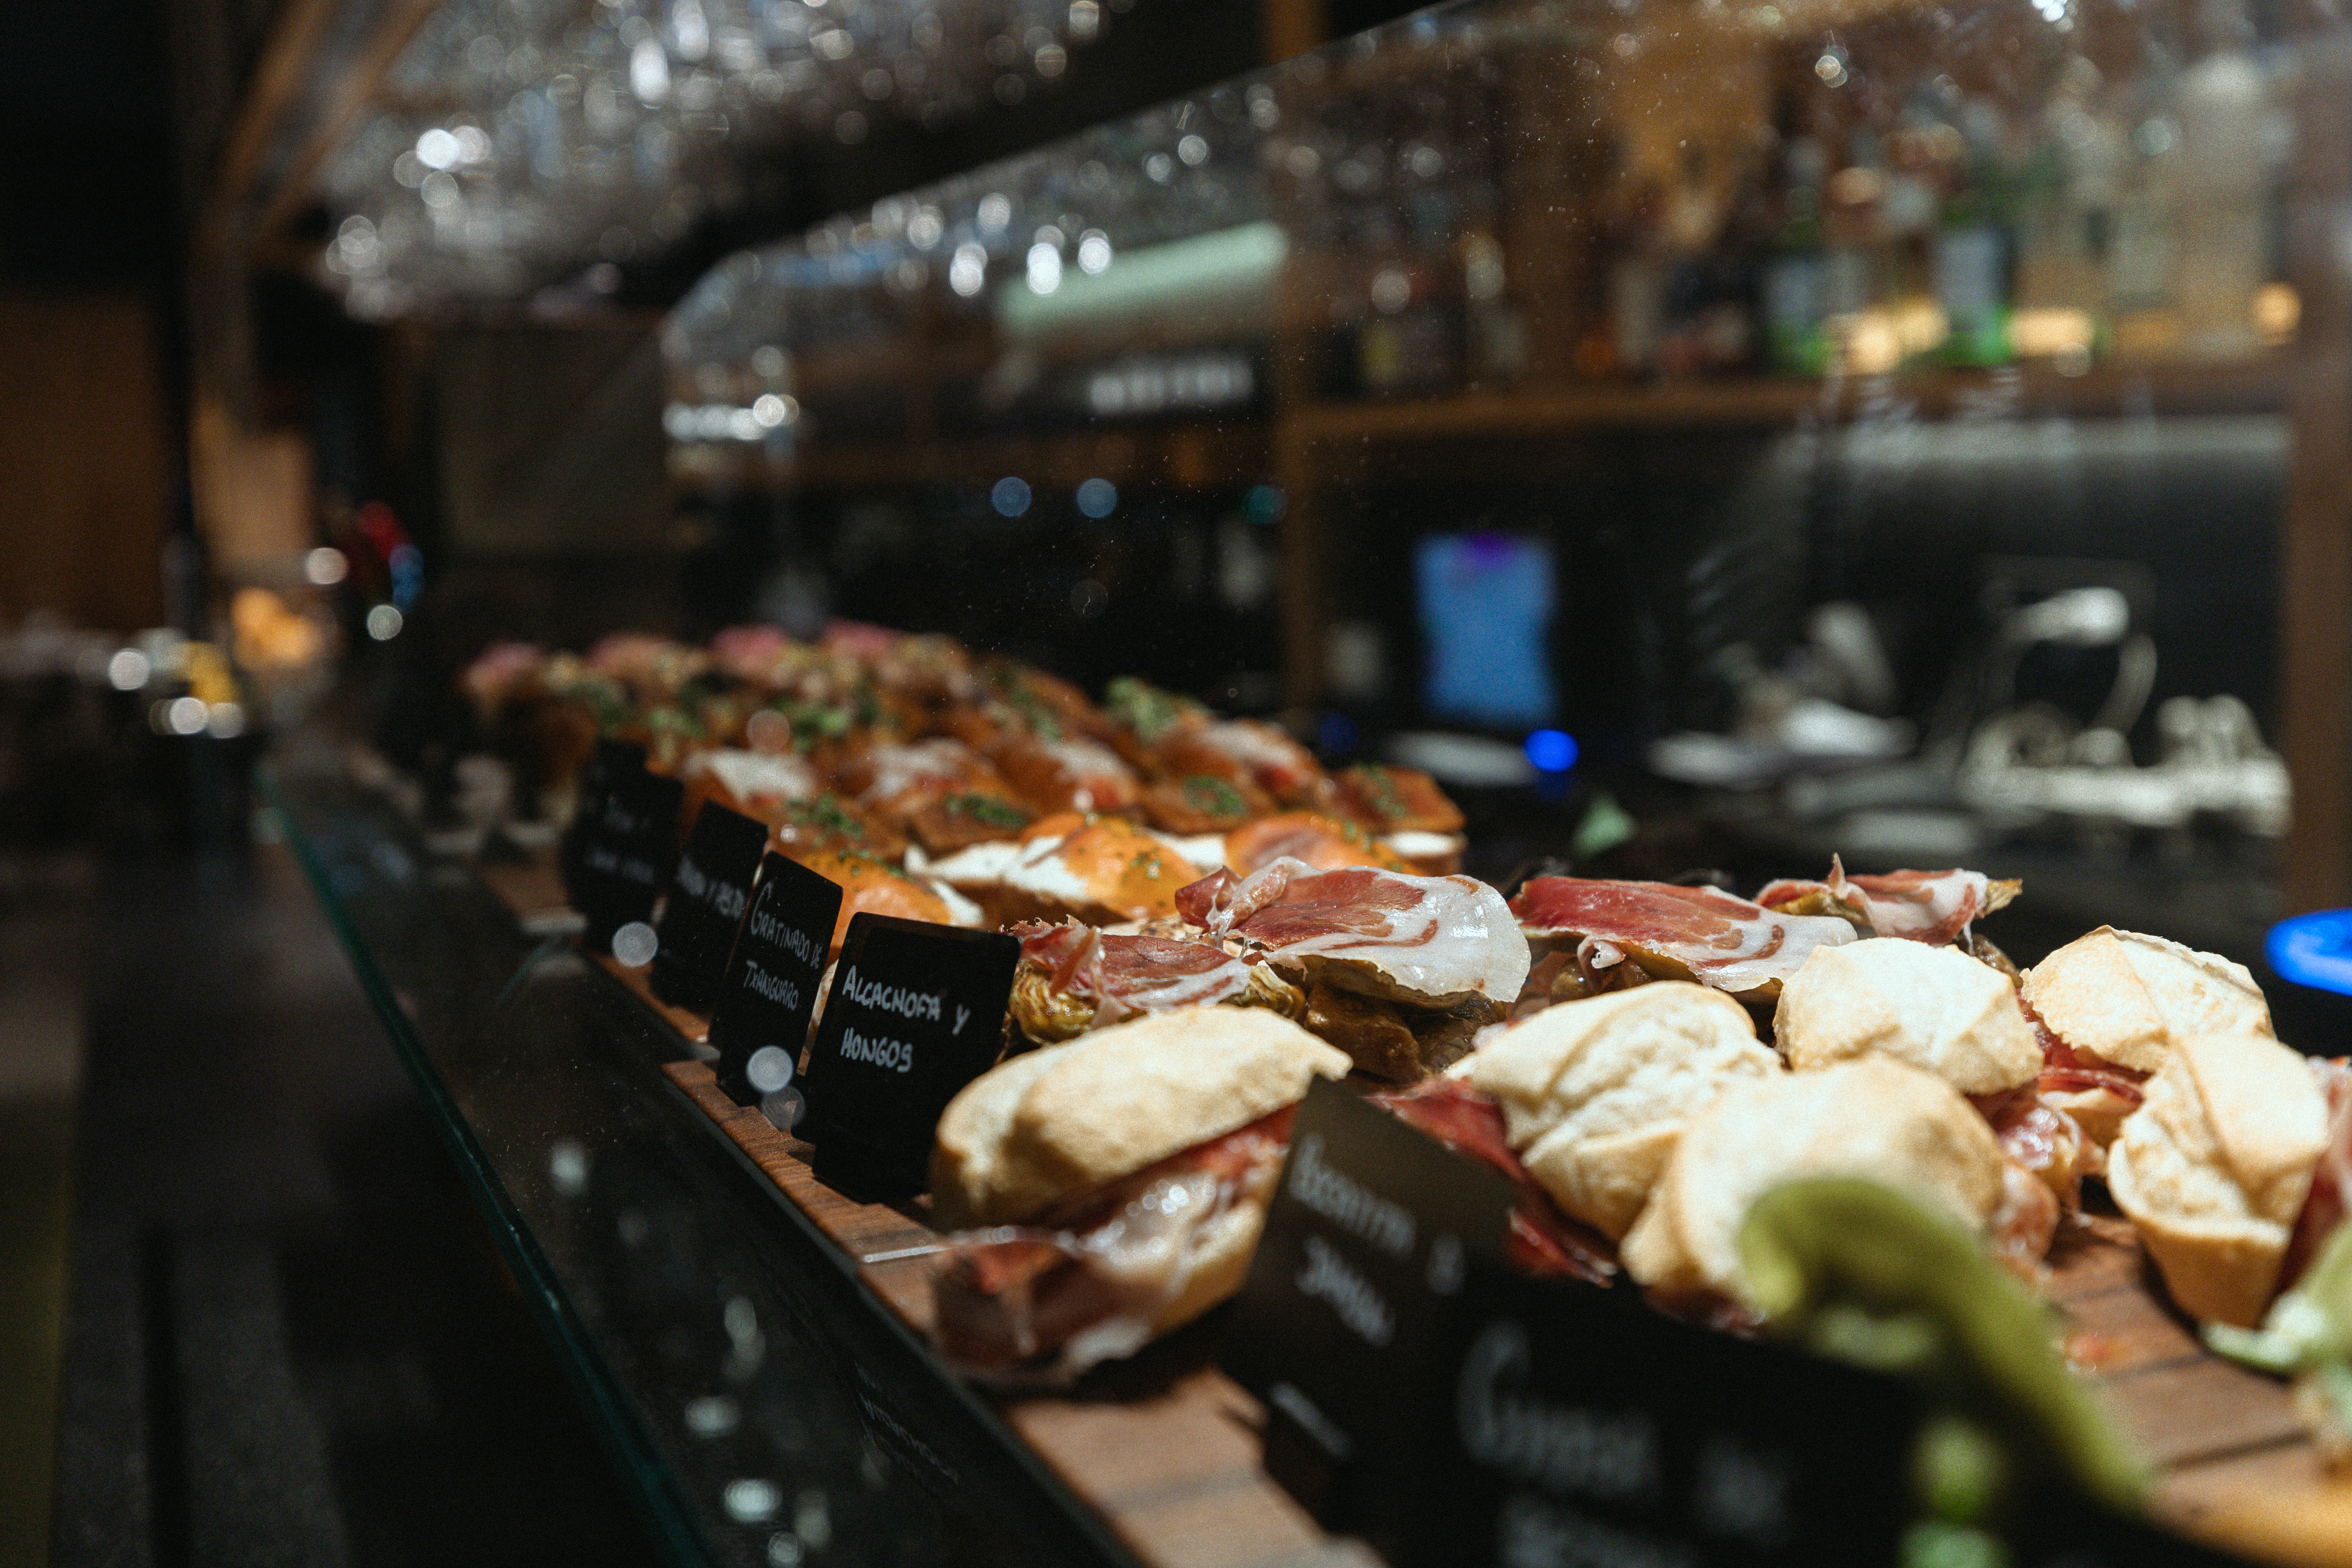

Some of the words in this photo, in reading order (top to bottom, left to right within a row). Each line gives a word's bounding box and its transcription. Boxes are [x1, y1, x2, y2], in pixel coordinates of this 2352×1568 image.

[750, 880, 811, 962] GRATINADO
[810, 943, 823, 970] DE
[952, 1003, 971, 1036] Y
[840, 1026, 914, 1074] HONGOS
